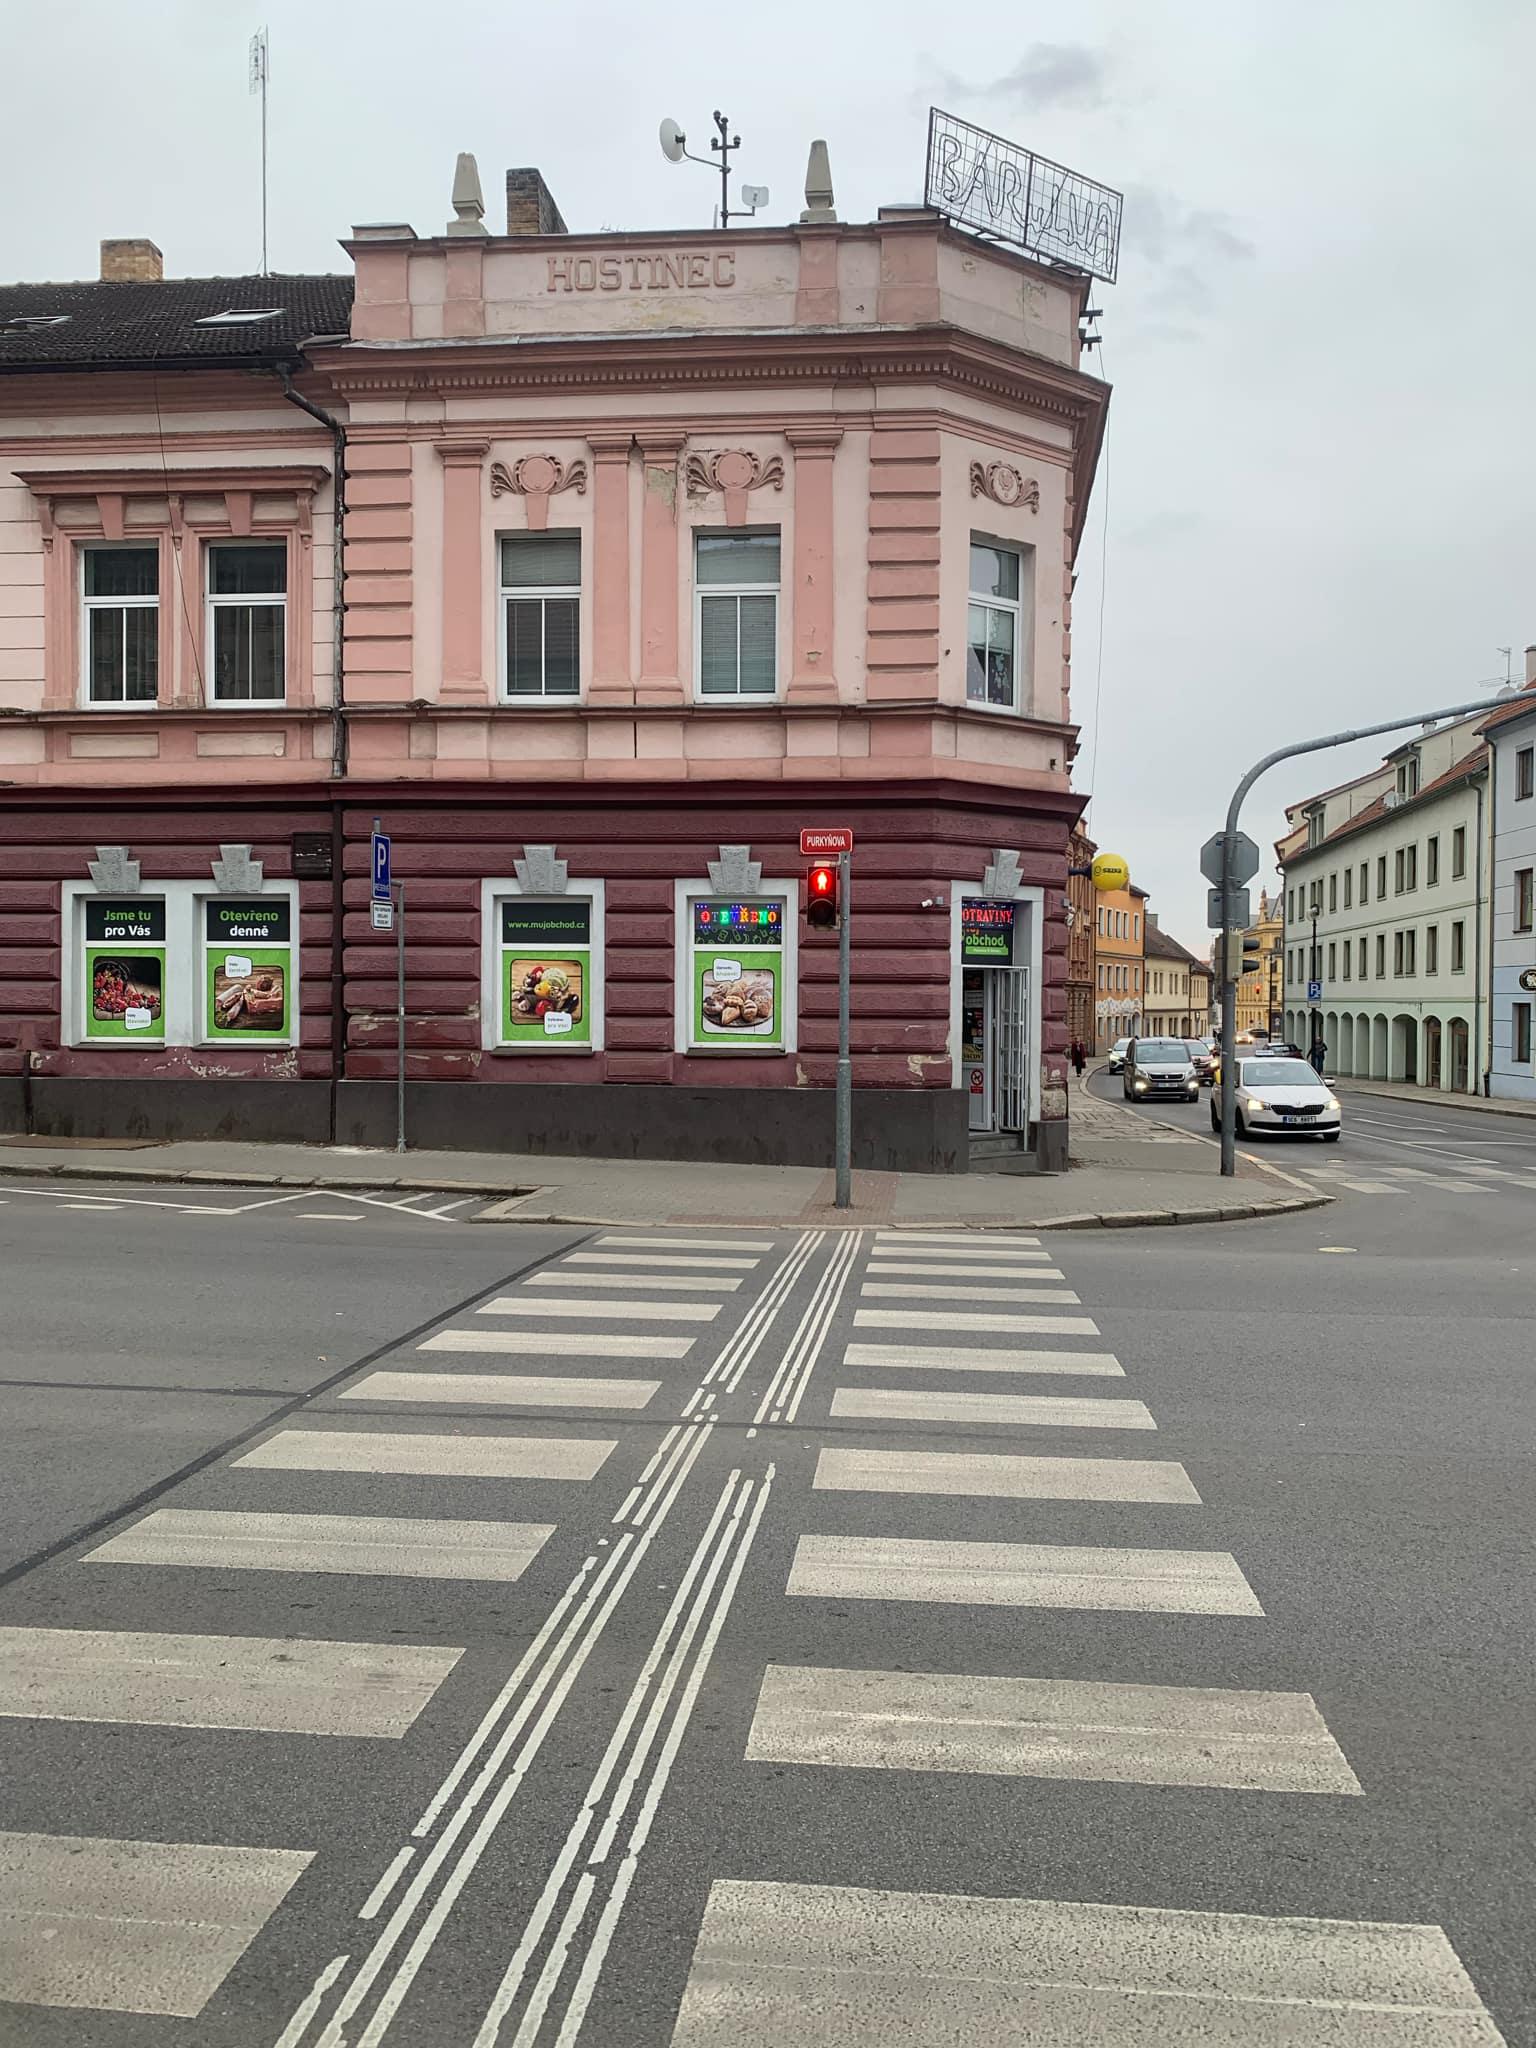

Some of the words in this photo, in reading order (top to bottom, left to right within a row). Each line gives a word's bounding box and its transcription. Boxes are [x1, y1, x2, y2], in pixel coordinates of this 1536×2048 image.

[547, 251, 736, 292] HOSTINEC
[806, 833, 846, 847] PURKYŇOVA
[377, 842, 387, 879] P
[103, 910, 136, 921] Jsme
[138, 910, 151, 921] tu
[219, 910, 279, 921] Otevřeno
[700, 907, 777, 923] OTEVŘENO
[962, 908, 1012, 923] OTRAVINY
[105, 927, 125, 938] pro
[128, 925, 151, 936] Vás
[229, 925, 269, 937] denně
[507, 920, 585, 930] www.mujobchod.cz
[965, 934, 1005, 946] obchod
